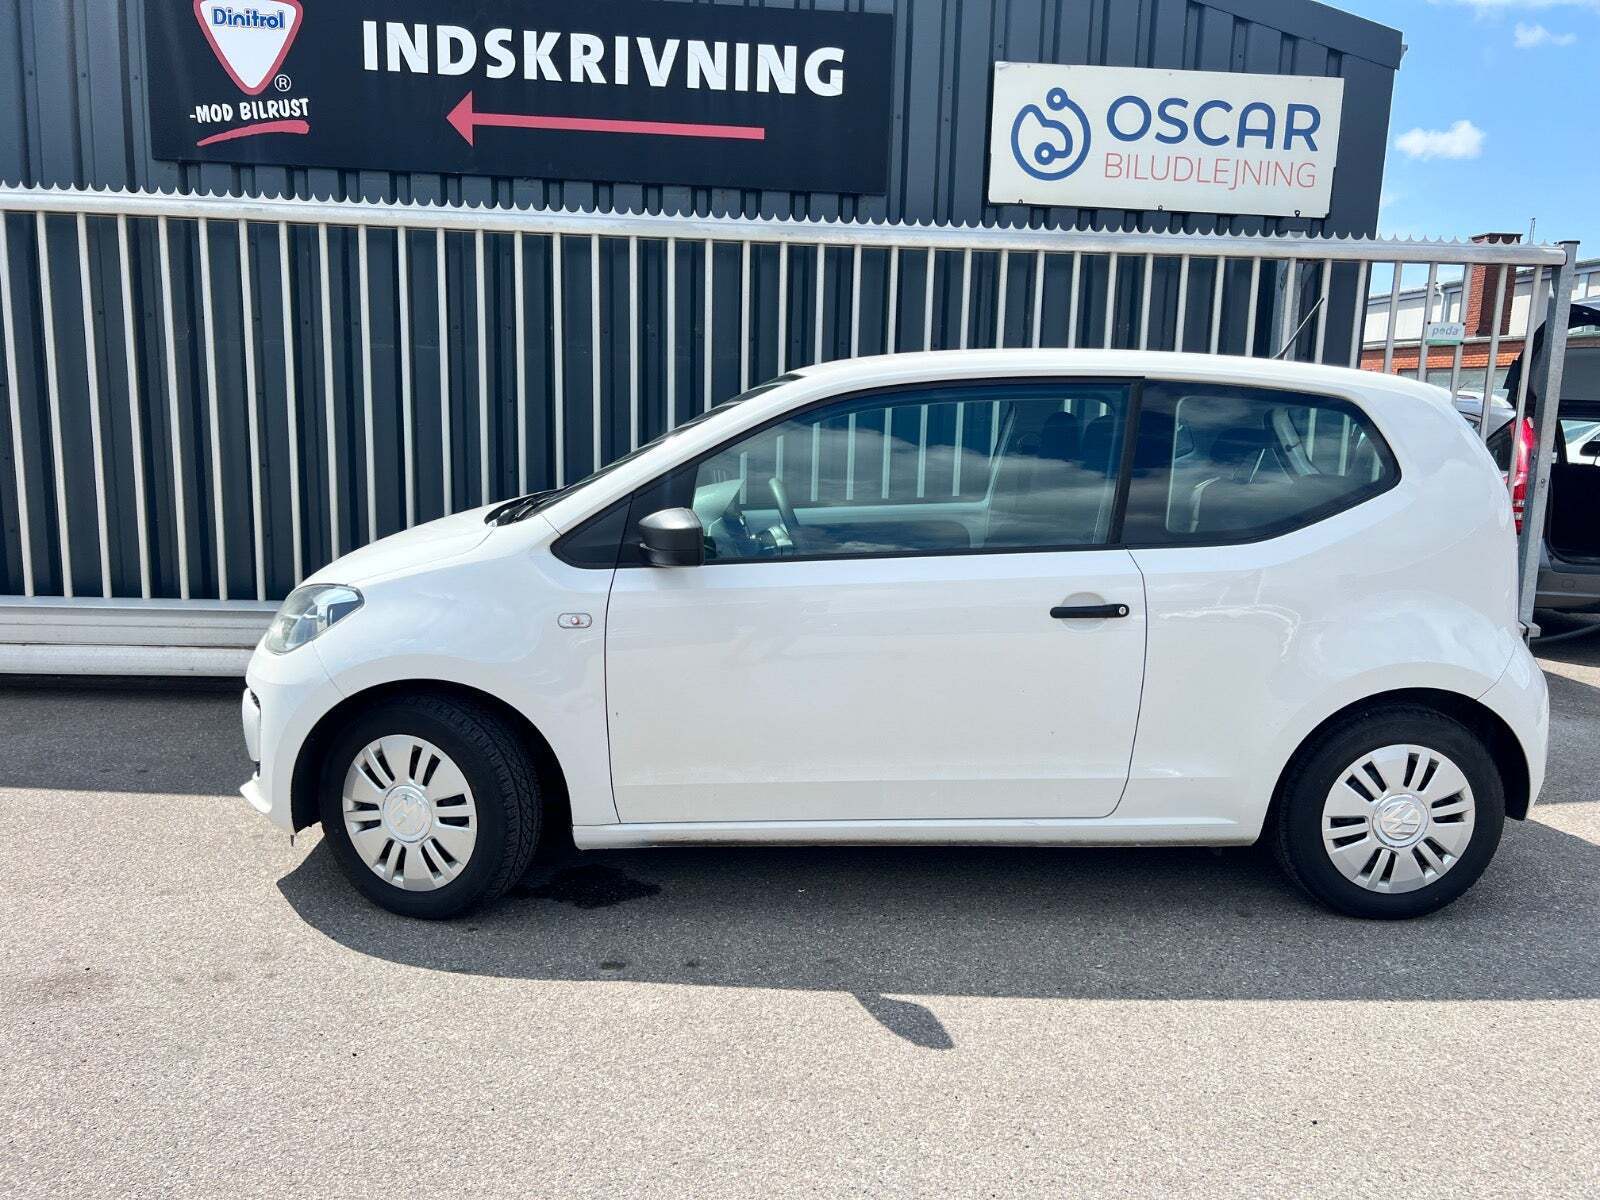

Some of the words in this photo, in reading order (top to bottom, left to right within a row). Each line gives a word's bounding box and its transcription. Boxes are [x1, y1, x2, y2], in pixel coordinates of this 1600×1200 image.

[212, 7, 286, 29] Dinitrol
[362, 20, 846, 97] INDSKRIVNING
[239, 98, 309, 121] BILRUST
[1106, 95, 1321, 152] OSCAR
[1104, 152, 1316, 190] BILUDLEJNING
